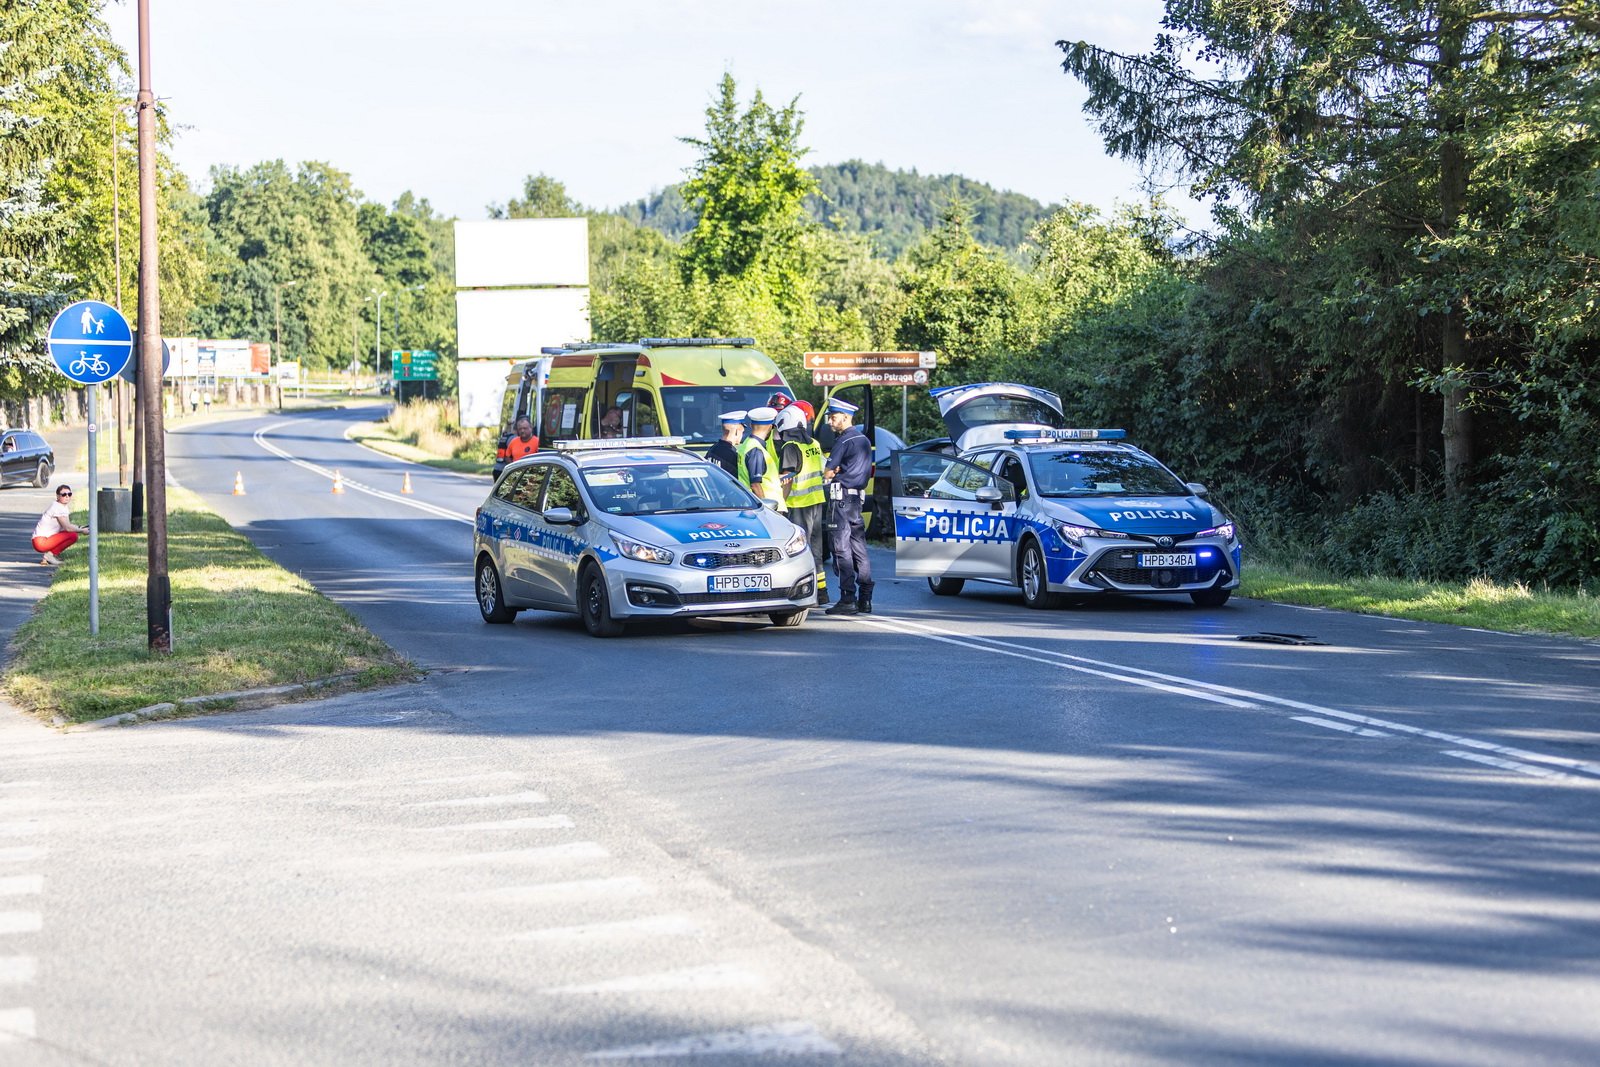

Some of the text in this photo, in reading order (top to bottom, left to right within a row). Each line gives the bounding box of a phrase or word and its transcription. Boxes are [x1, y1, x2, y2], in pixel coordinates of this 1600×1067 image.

[856, 356, 878, 364] Historii
[835, 373, 846, 381] km
[848, 373, 882, 381] Siedlisko
[884, 373, 912, 383] Pstrąga
[780, 397, 786, 405] 2
[1047, 429, 1079, 438] POLICJA
[1109, 509, 1197, 522] POLICJA
[925, 514, 1009, 538] POLICJA
[688, 529, 758, 540] POLICJA
[541, 535, 566, 554] POLICJA
[1144, 555, 1166, 567] HPB
[1168, 555, 1194, 567] 34BA
[715, 577, 740, 589] HPB
[743, 576, 770, 588] C578
